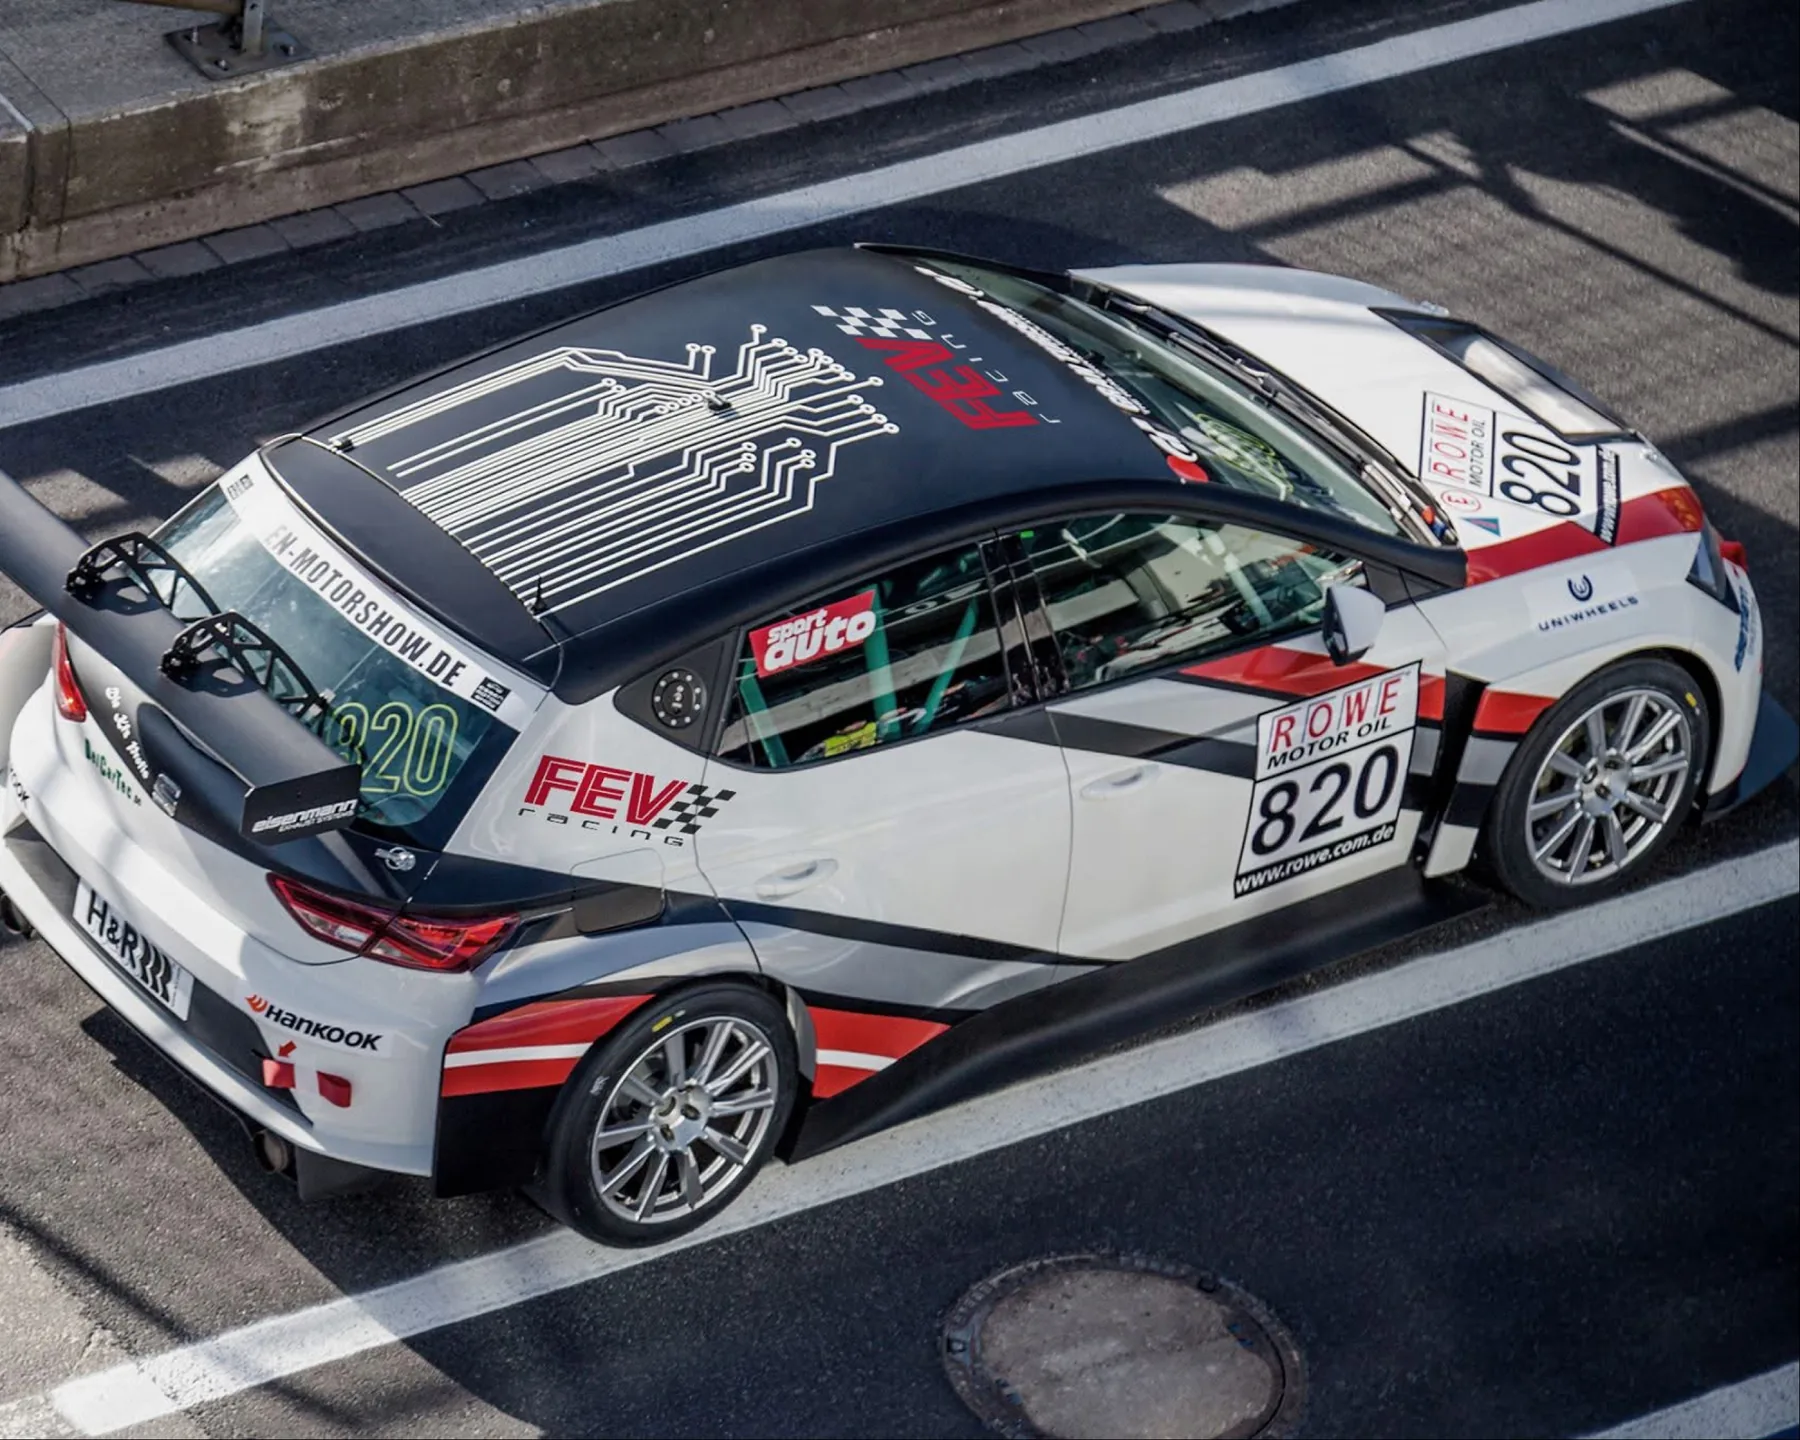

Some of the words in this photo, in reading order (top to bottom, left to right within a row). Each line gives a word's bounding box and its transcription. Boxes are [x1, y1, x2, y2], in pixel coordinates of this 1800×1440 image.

[854, 336, 1041, 430] FEV
[1431, 404, 1469, 482] ROWE
[1470, 418, 1488, 439] OIL
[1468, 439, 1486, 491] MOTOR
[1499, 431, 1582, 517] 820
[764, 610, 876, 671] auto
[767, 608, 828, 645] sport
[1538, 596, 1640, 632] UNIWHEELS
[1266, 731, 1349, 770] MOTOR
[1356, 717, 1392, 738] OIL
[1270, 677, 1402, 753] ROWE
[251, 799, 358, 832] eisenmann
[523, 754, 689, 826] FEV
[1250, 743, 1400, 856] 820
[1235, 824, 1396, 895] www.rowe.com.de
[87, 888, 137, 970] H&R
